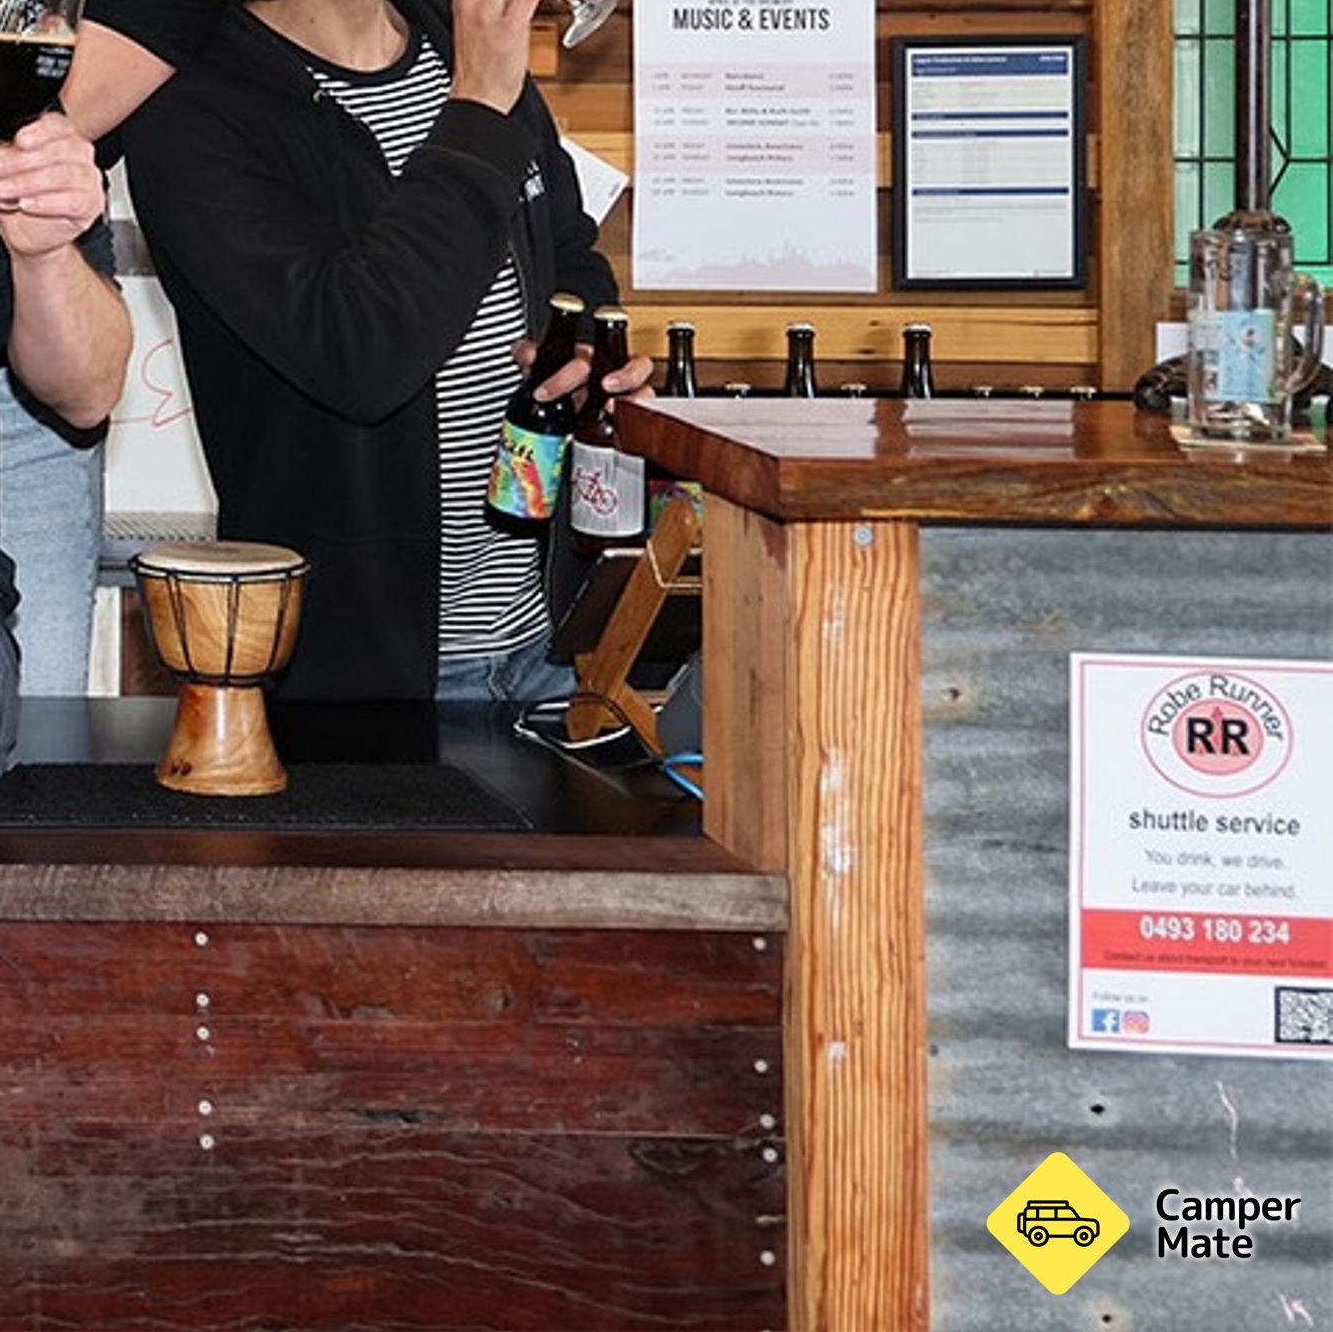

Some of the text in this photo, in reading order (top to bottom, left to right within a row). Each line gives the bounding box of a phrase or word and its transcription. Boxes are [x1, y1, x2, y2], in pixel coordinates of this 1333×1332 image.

[672, 7, 831, 31] MUSIC & EVENTS
[1147, 673, 1284, 743] Robe Runner
[1186, 716, 1251, 755] RR
[1128, 809, 1301, 836] shuttle service
[1145, 848, 1173, 865] You
[1222, 856, 1243, 868] we
[1132, 878, 1177, 893] Leave
[1181, 882, 1214, 898] your
[1217, 884, 1241, 897] car
[1139, 916, 1290, 945] 0493 180 234
